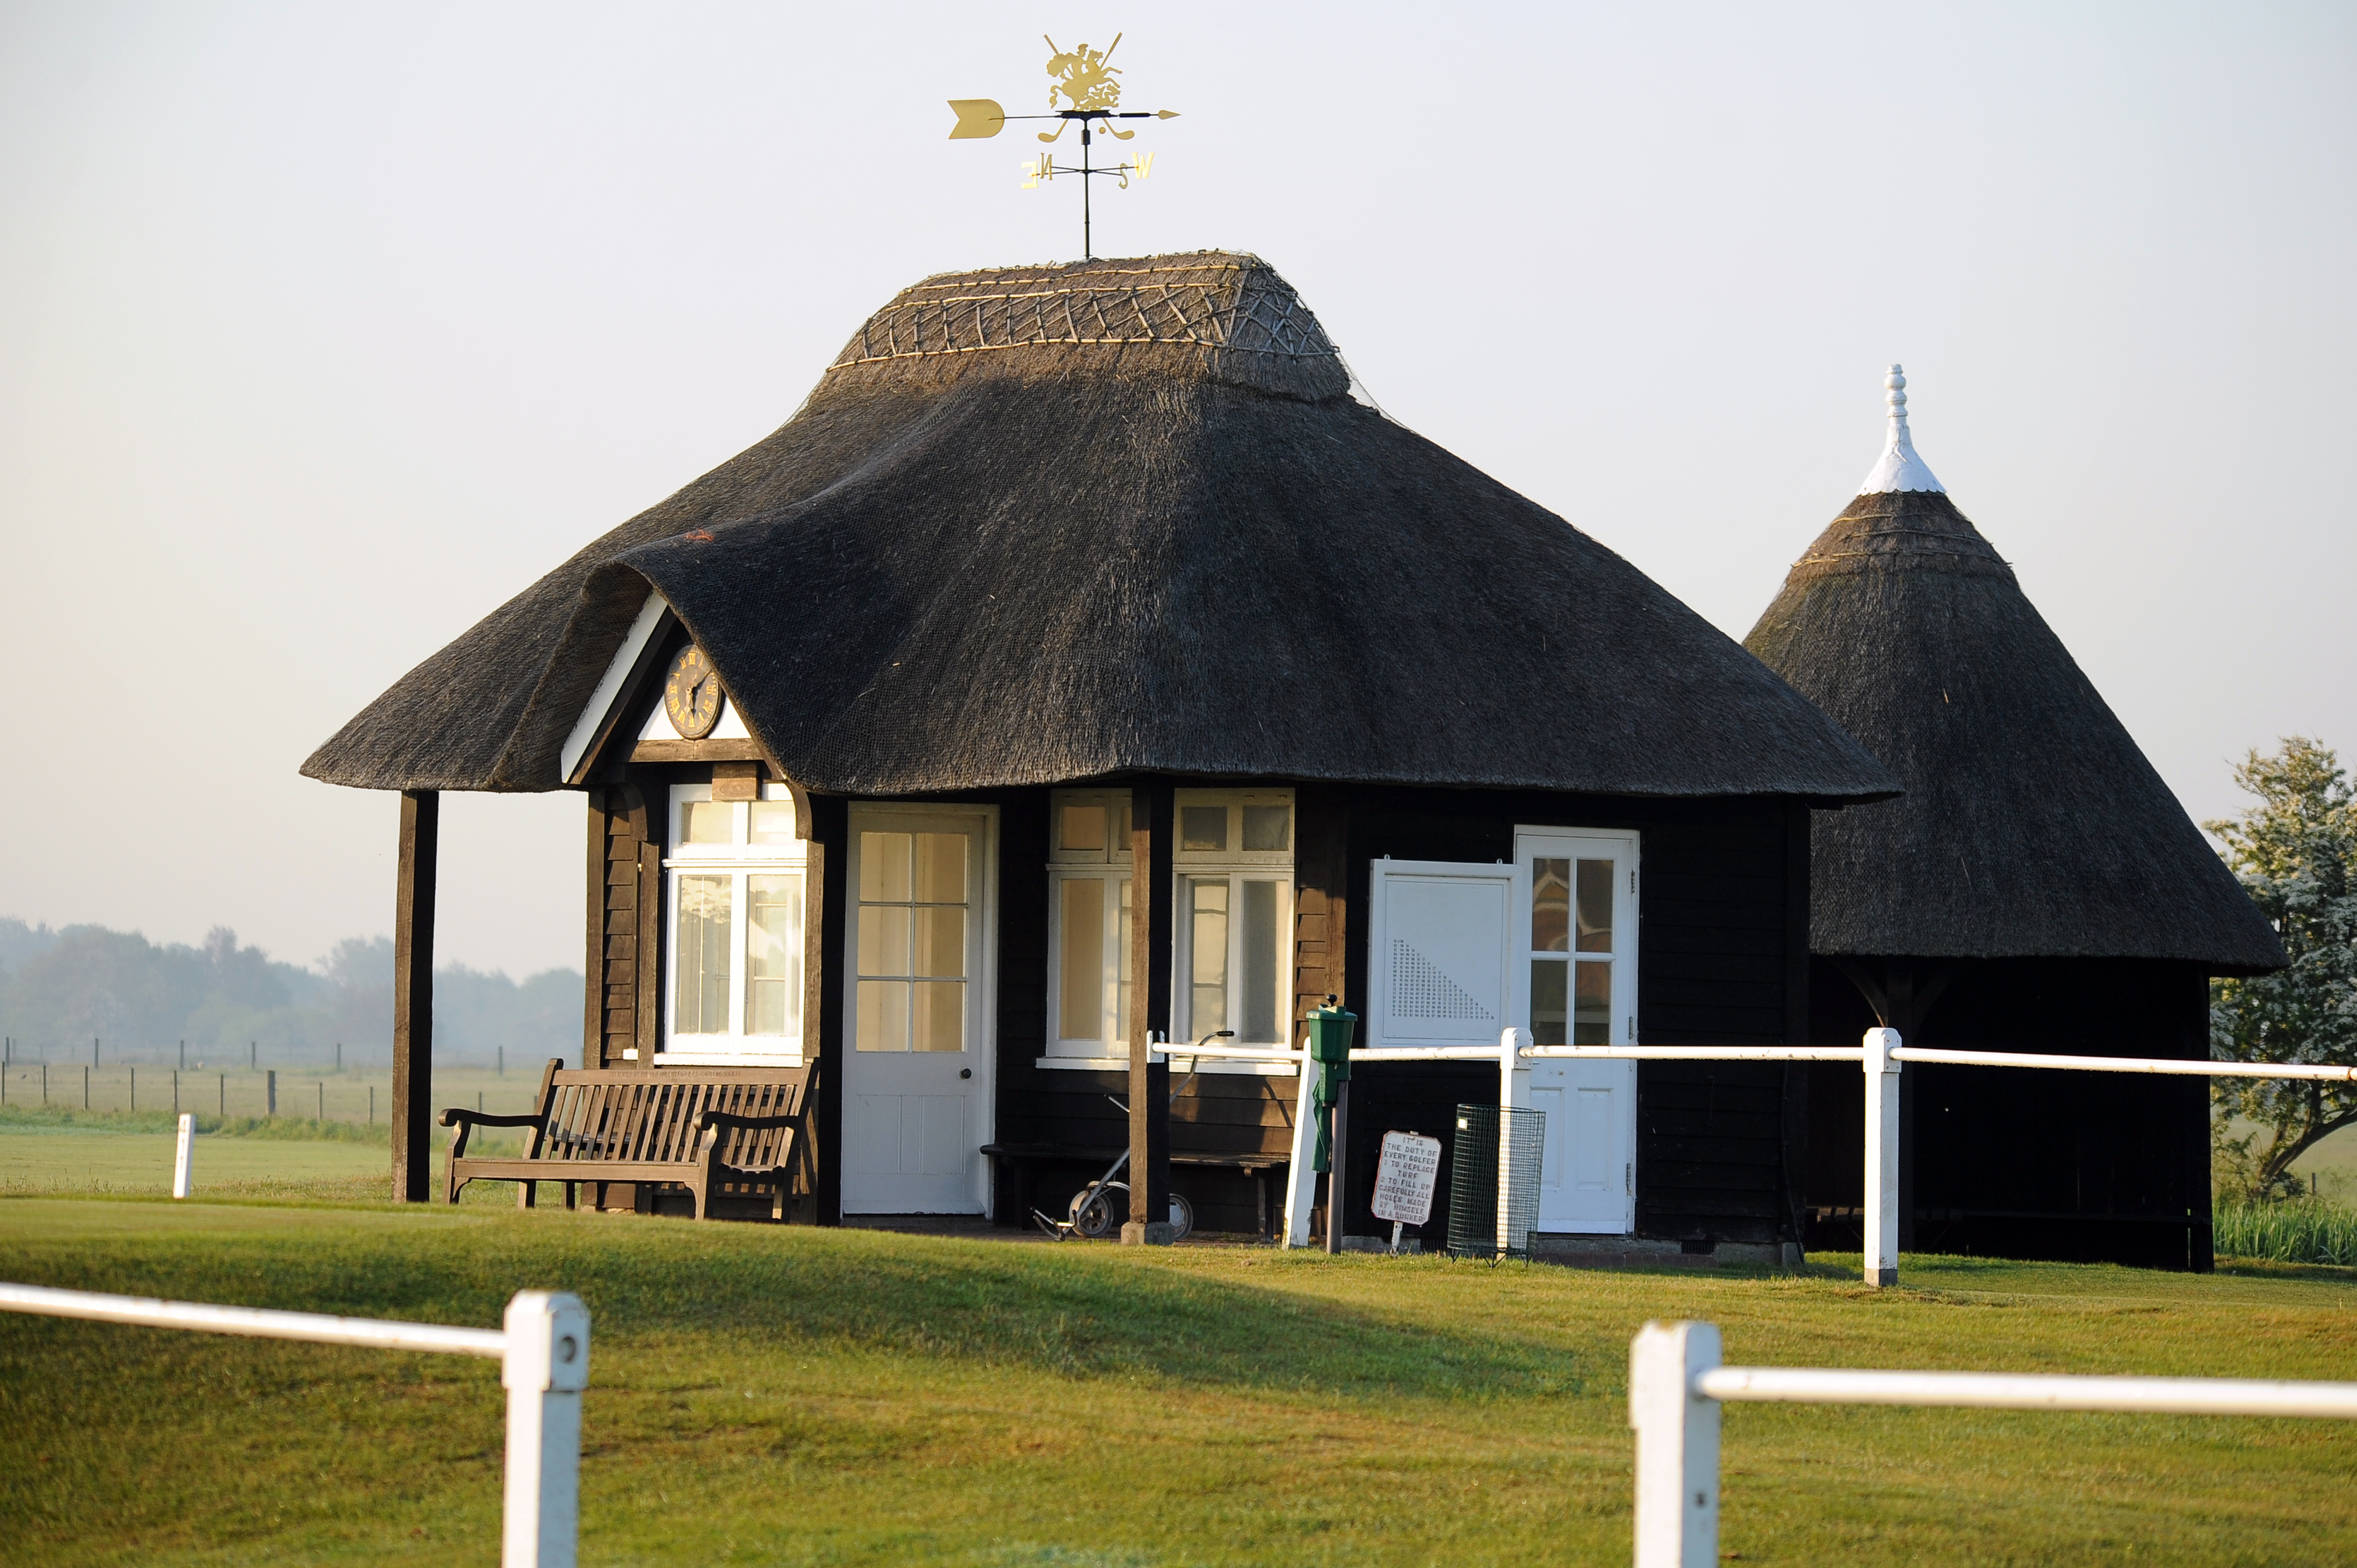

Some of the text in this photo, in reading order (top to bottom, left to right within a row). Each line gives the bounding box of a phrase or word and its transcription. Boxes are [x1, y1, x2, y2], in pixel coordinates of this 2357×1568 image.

[1132, 152, 1155, 179] W
[1118, 163, 1128, 189] S
[1387, 1142, 1401, 1151] THE
[1405, 1146, 1424, 1155] DUTY
[1385, 1151, 1435, 1165] EVERY GOLFER
[1398, 1170, 1418, 1179] TURF
[1403, 1162, 1435, 1174] REPLACE
[1401, 1179, 1416, 1188] FILL
[1378, 1184, 1430, 1199] CAREFULLY ALL
[1380, 1193, 1425, 1207] HOLES MADE
